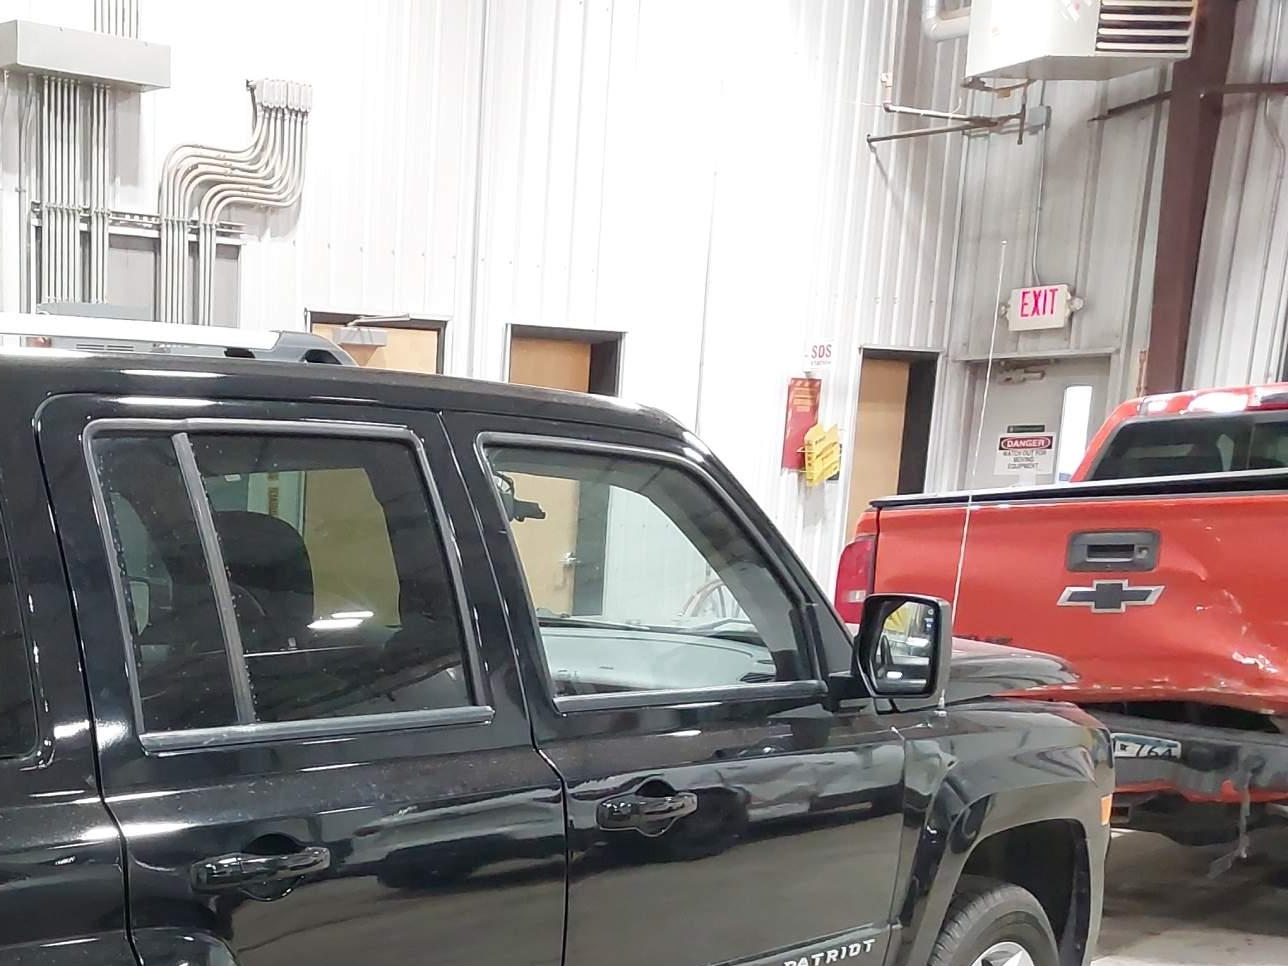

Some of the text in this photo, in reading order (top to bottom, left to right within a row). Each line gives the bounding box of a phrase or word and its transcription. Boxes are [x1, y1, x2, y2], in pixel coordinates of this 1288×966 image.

[1020, 288, 1059, 317] EXIT
[811, 344, 832, 359] SDS
[1006, 439, 1045, 448] DANGER
